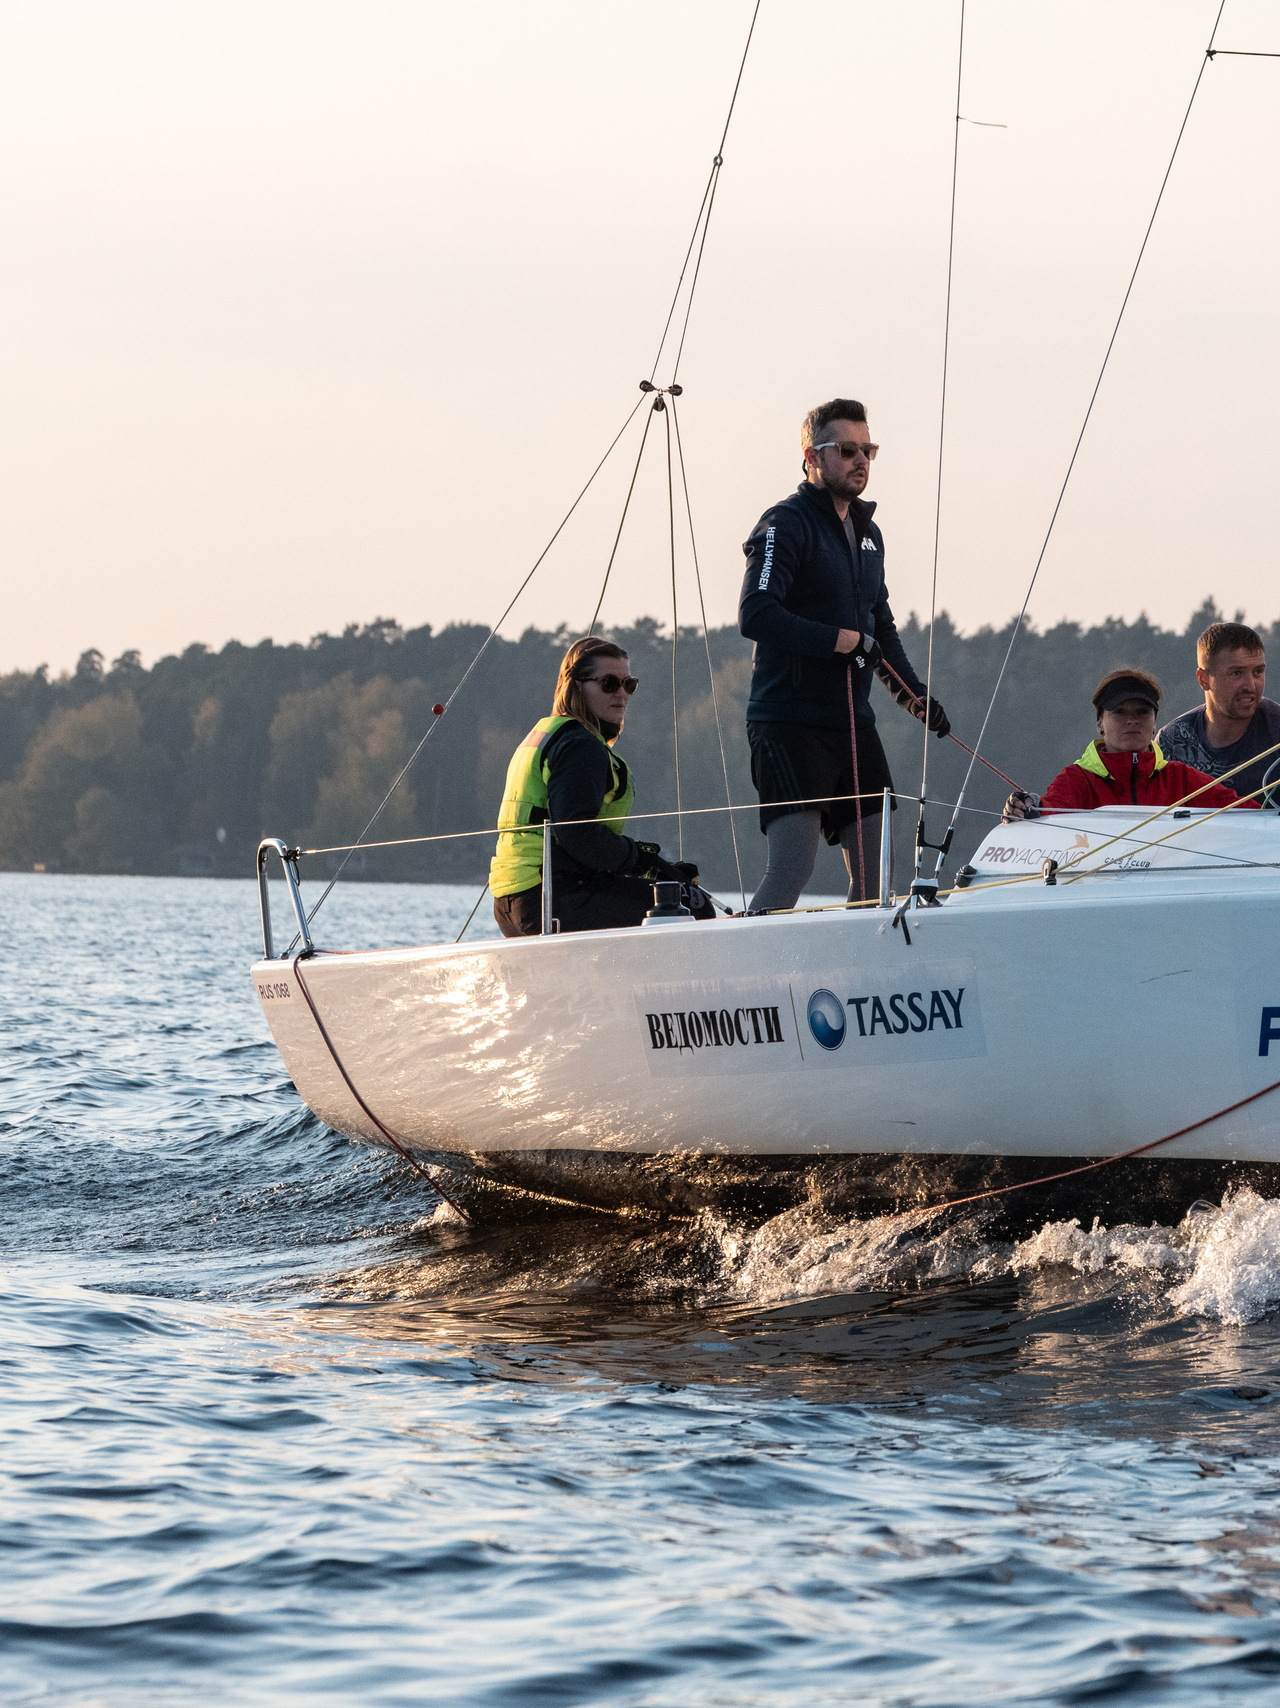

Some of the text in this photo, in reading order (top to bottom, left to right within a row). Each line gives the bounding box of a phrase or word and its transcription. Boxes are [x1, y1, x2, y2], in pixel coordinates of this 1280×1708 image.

[1130, 860, 1151, 868] CLUB
[258, 984, 275, 1000] RUS
[846, 987, 966, 1037] TASSAY
[645, 1005, 785, 1056] ВЕДОМОСТИ
